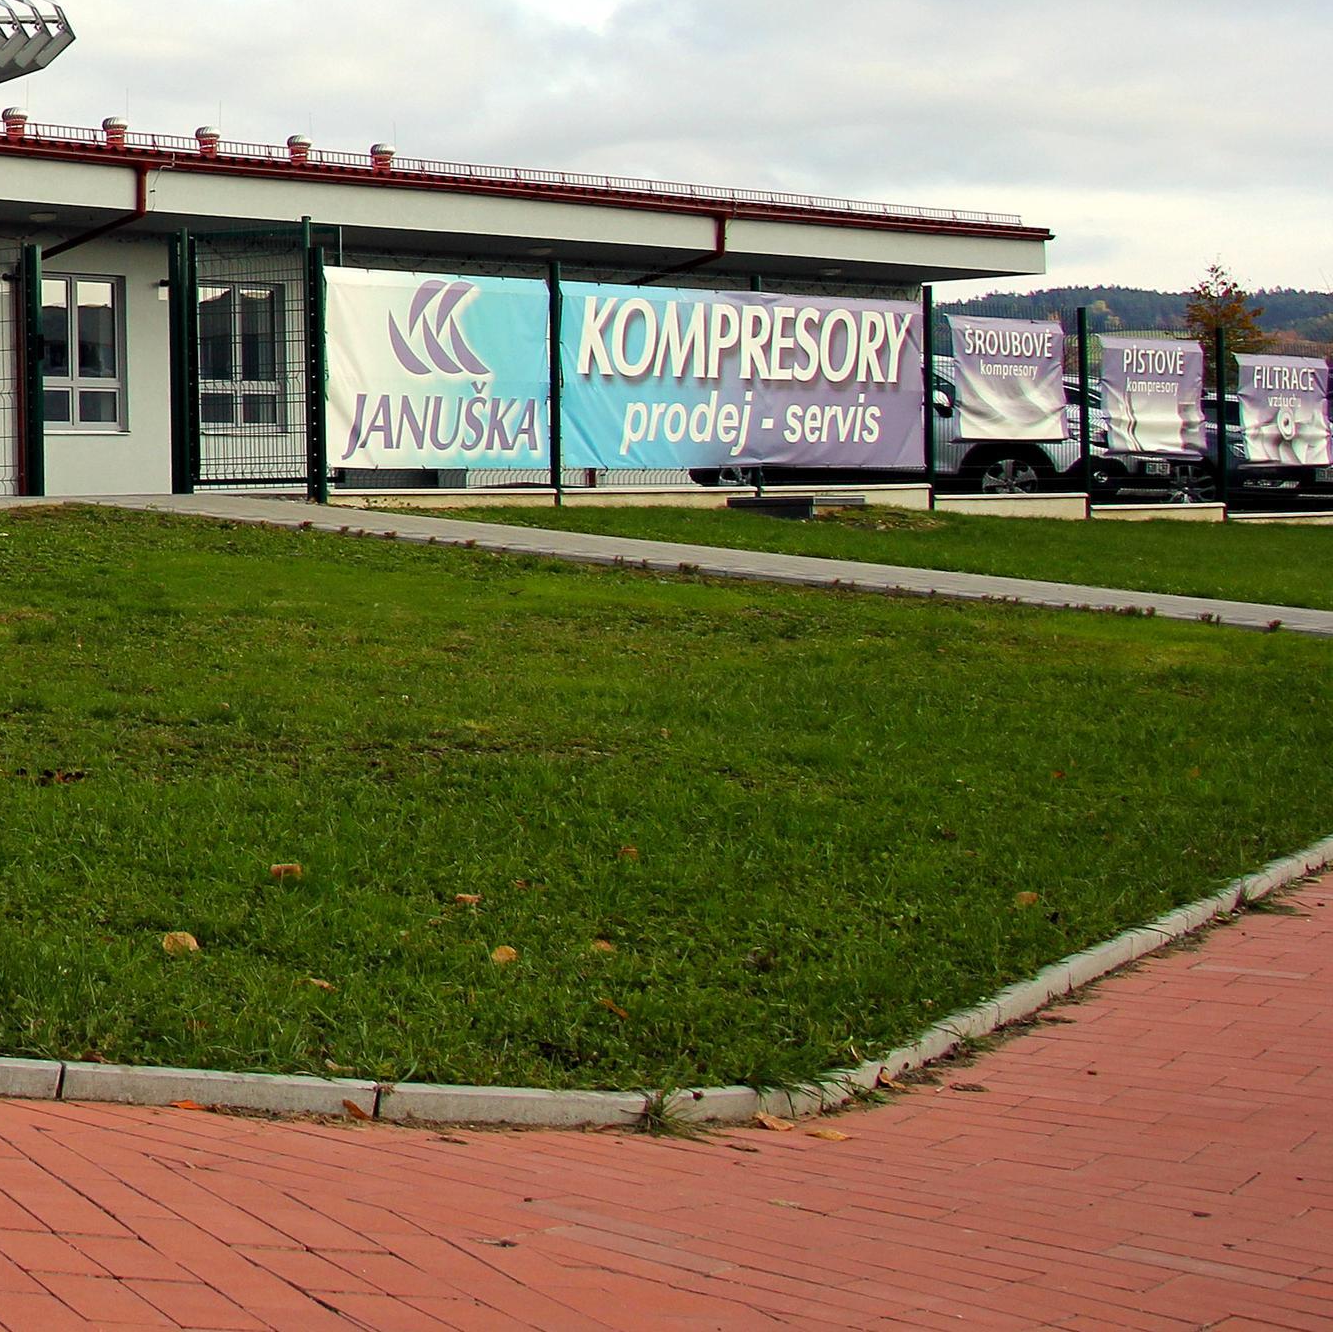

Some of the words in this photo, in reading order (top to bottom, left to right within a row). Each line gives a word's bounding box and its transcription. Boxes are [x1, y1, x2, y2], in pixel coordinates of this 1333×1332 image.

[576, 295, 913, 384] KOMPRESORY
[964, 323, 1053, 358] ŠROUBOVÉ
[980, 359, 1038, 381] kompresory
[1123, 344, 1184, 375] PÍSTOVÉ
[1126, 376, 1179, 397] kompresory
[1253, 366, 1315, 391] FILTRACE
[341, 381, 538, 461] JANUŠKA
[619, 390, 753, 456] prodej
[784, 393, 881, 444] servis
